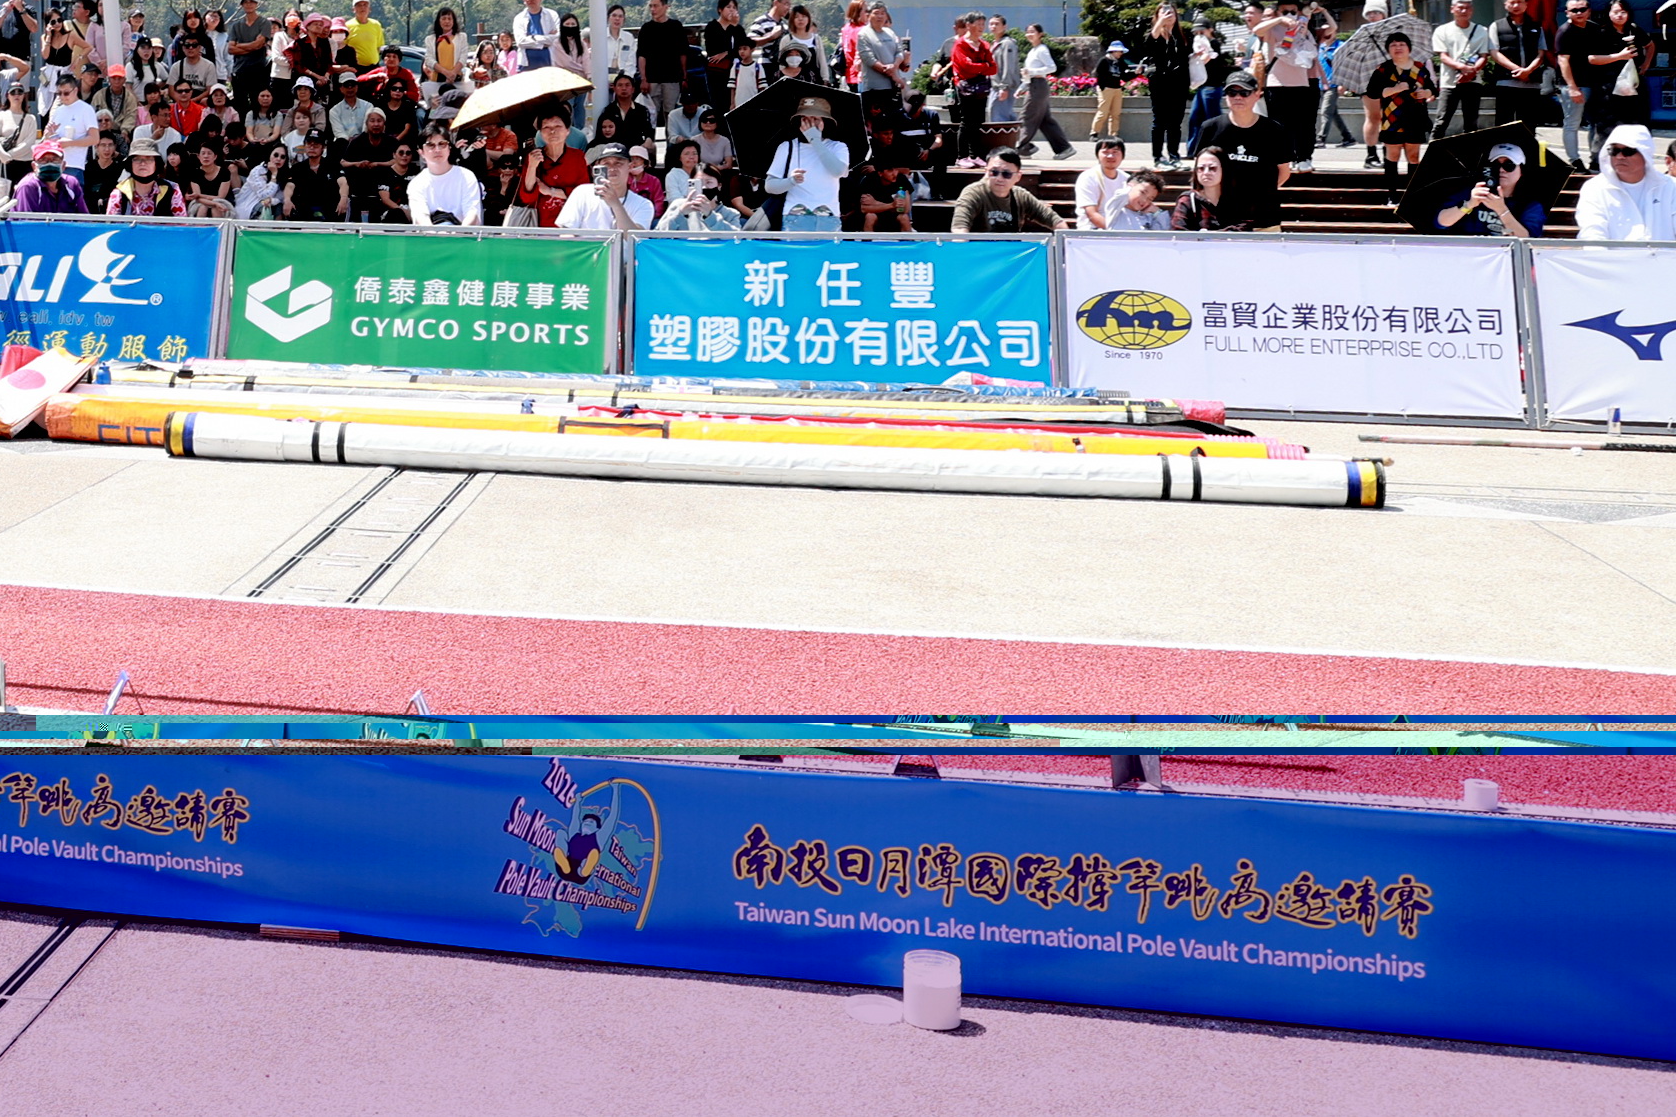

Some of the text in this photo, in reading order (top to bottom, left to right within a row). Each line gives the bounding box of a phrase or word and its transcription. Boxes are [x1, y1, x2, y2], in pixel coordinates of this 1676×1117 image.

[354, 275, 590, 312] 僑泰鑫健康事業
[742, 259, 937, 309] 新任豐
[350, 316, 590, 346] GYMCO SPORTS
[1201, 300, 1504, 337] 富貿企業股份有限公司
[648, 313, 1042, 368] 塑膠股份有限公司
[1104, 350, 1164, 361] Since 1970
[1203, 335, 1504, 362] FULL MORE ENTERPRISE CO.,LTD
[541, 757, 578, 809] 2026
[504, 795, 557, 854] Sun Moon
[11, 836, 50, 857] Pole
[52, 839, 99, 862] Vault
[101, 845, 244, 879] Championships
[608, 835, 638, 878] Taiwan
[495, 858, 638, 913] Pole Vault Championships
[594, 864, 642, 898] ernational
[734, 901, 1426, 983] Taiwan Sun Moon Lake International Pole Vault Championships
